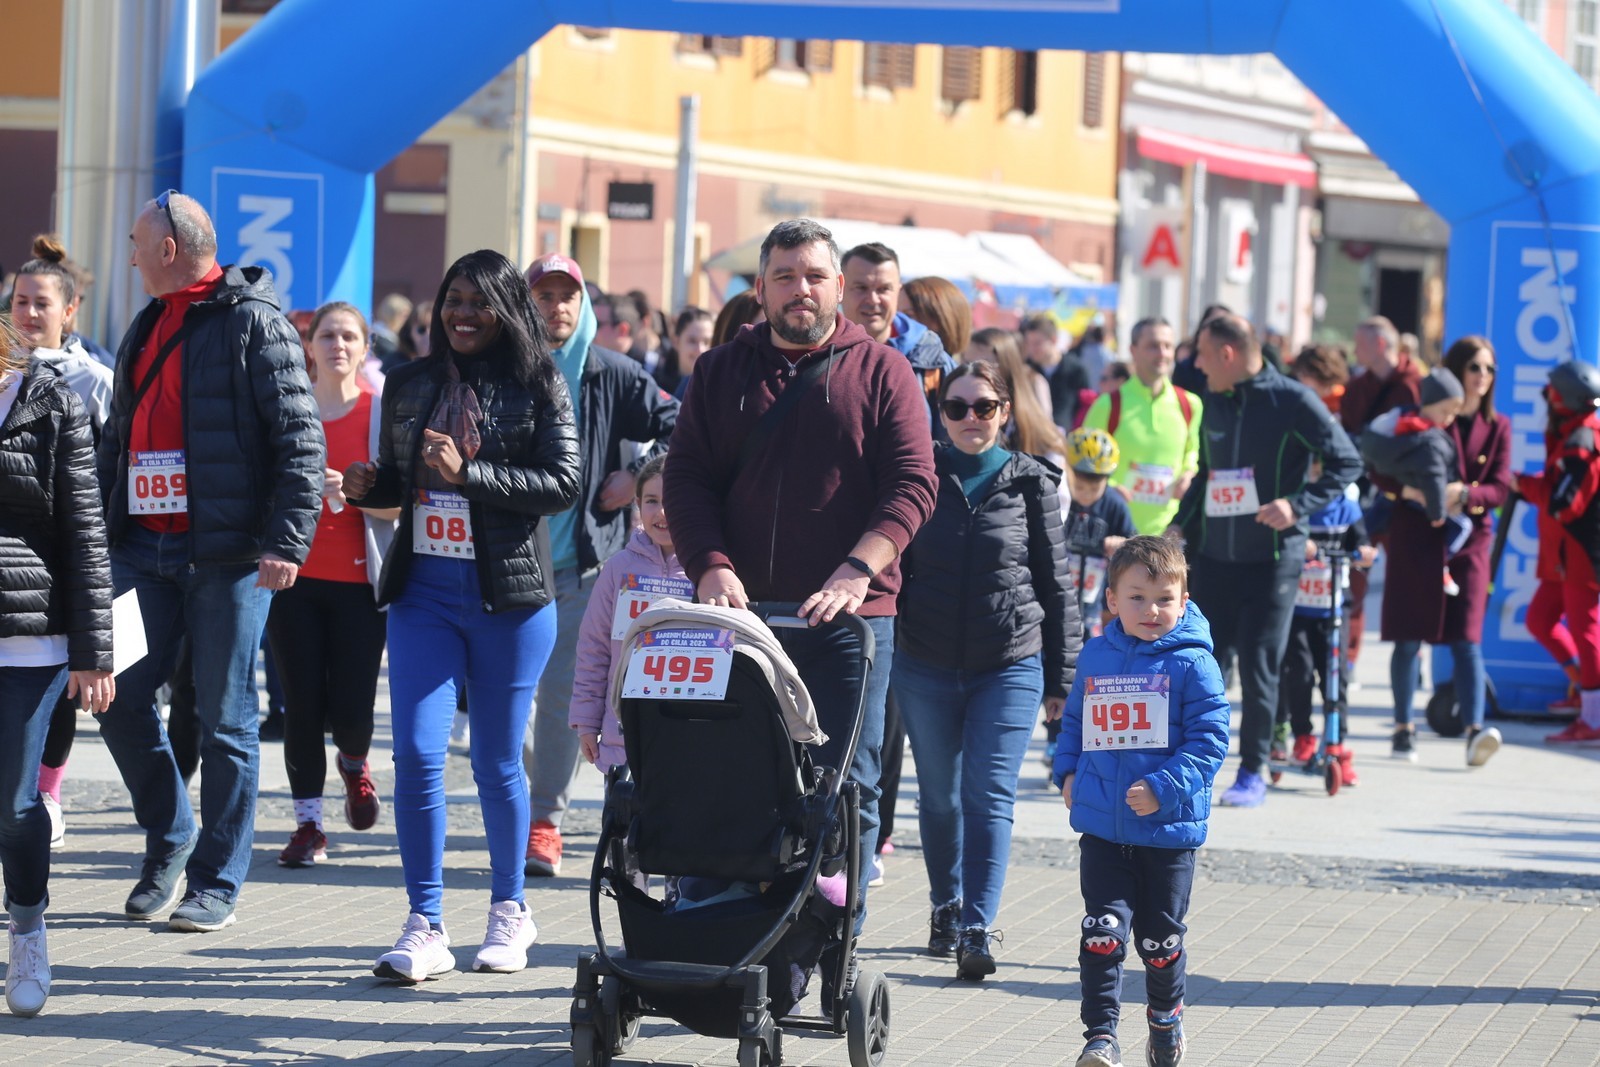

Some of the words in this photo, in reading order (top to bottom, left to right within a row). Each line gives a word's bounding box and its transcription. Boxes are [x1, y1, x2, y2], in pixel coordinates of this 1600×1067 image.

[1141, 223, 1181, 268] A
[1498, 247, 1579, 642] DECTHLON
[135, 472, 187, 499] 089
[1211, 485, 1245, 505] 457
[426, 515, 474, 542] 08
[670, 639, 688, 647] CILJA
[681, 631, 714, 640] ČARAPAMA
[643, 655, 715, 684] 495
[1115, 676, 1149, 685] ČARAPAMA
[1092, 702, 1152, 732] 491
